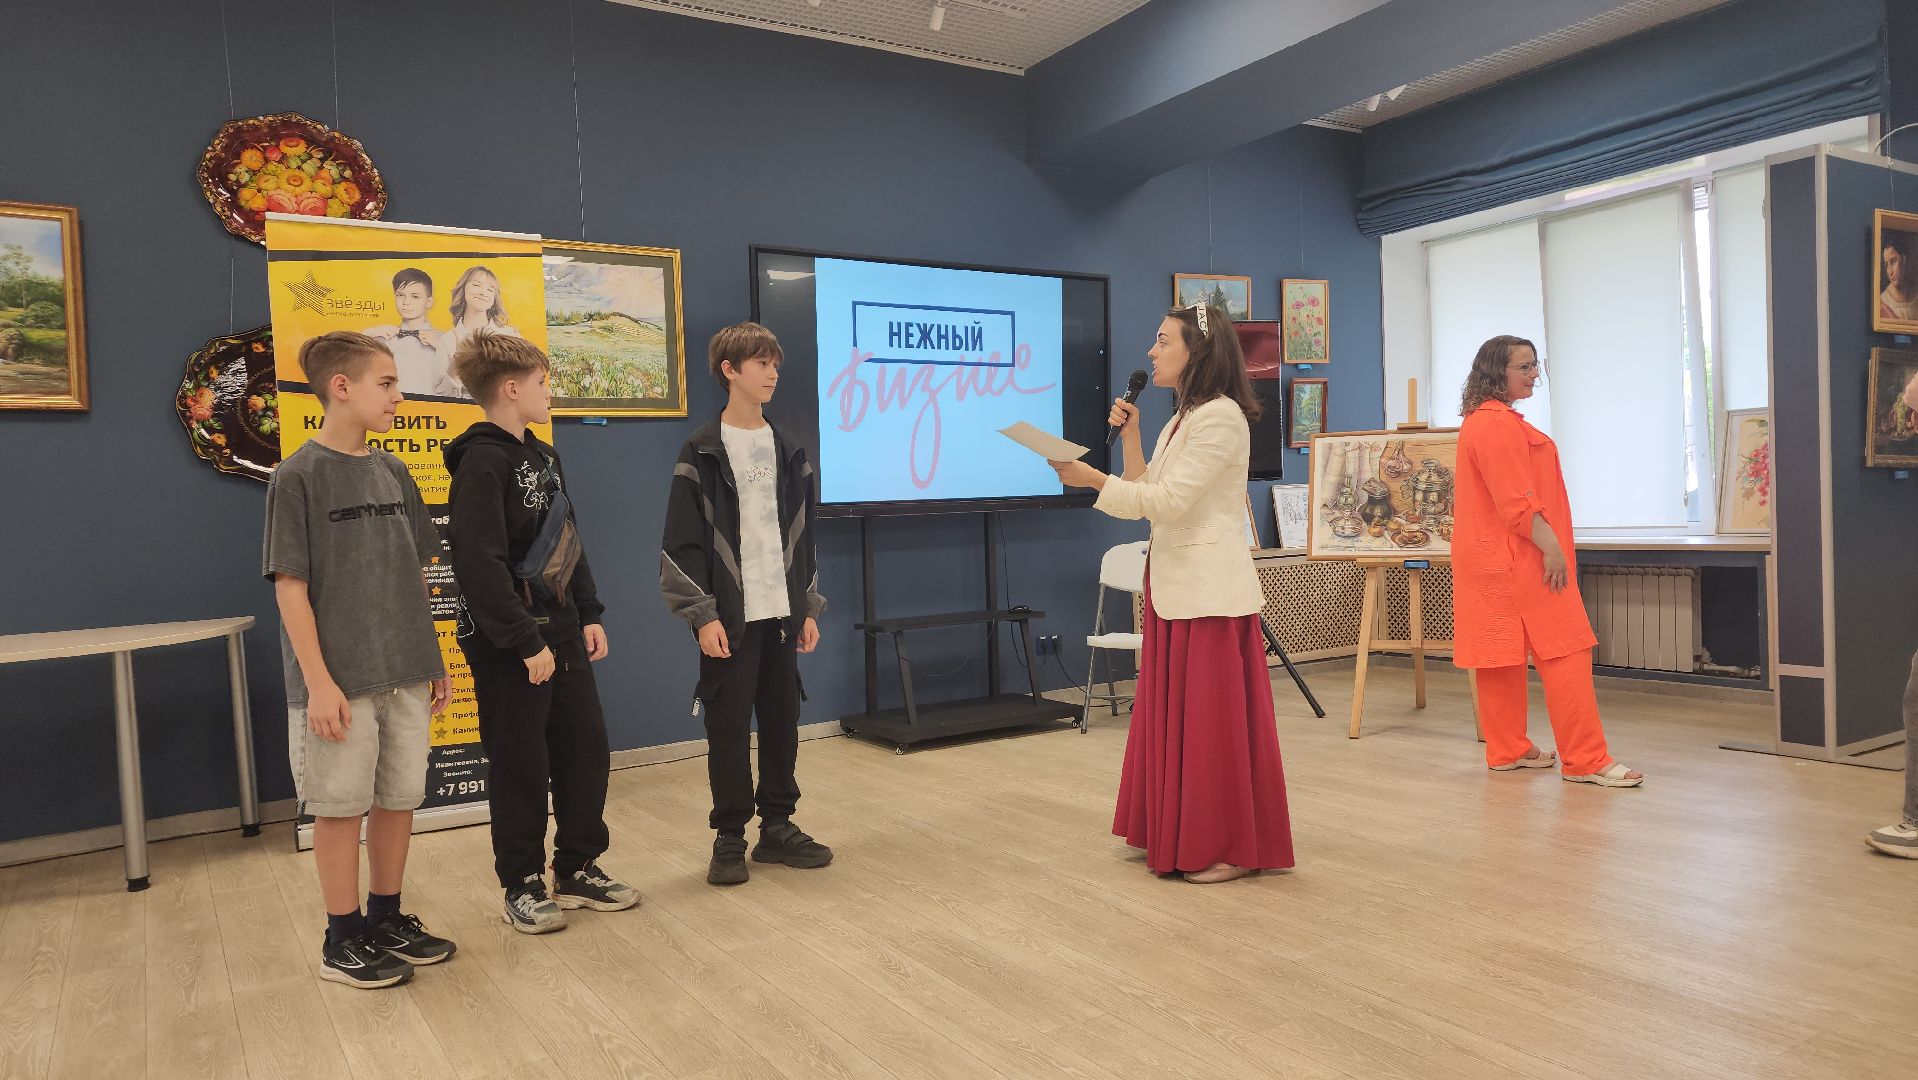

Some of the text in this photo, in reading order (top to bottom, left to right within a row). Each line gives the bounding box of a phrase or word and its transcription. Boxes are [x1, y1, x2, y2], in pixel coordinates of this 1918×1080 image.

[888, 320, 984, 352] НЕЖНЫЙ
[394, 415, 447, 430] ВИТЬ
[368, 438, 450, 453] ОСТЬ РЕ
[436, 779, 485, 797] +7 991
